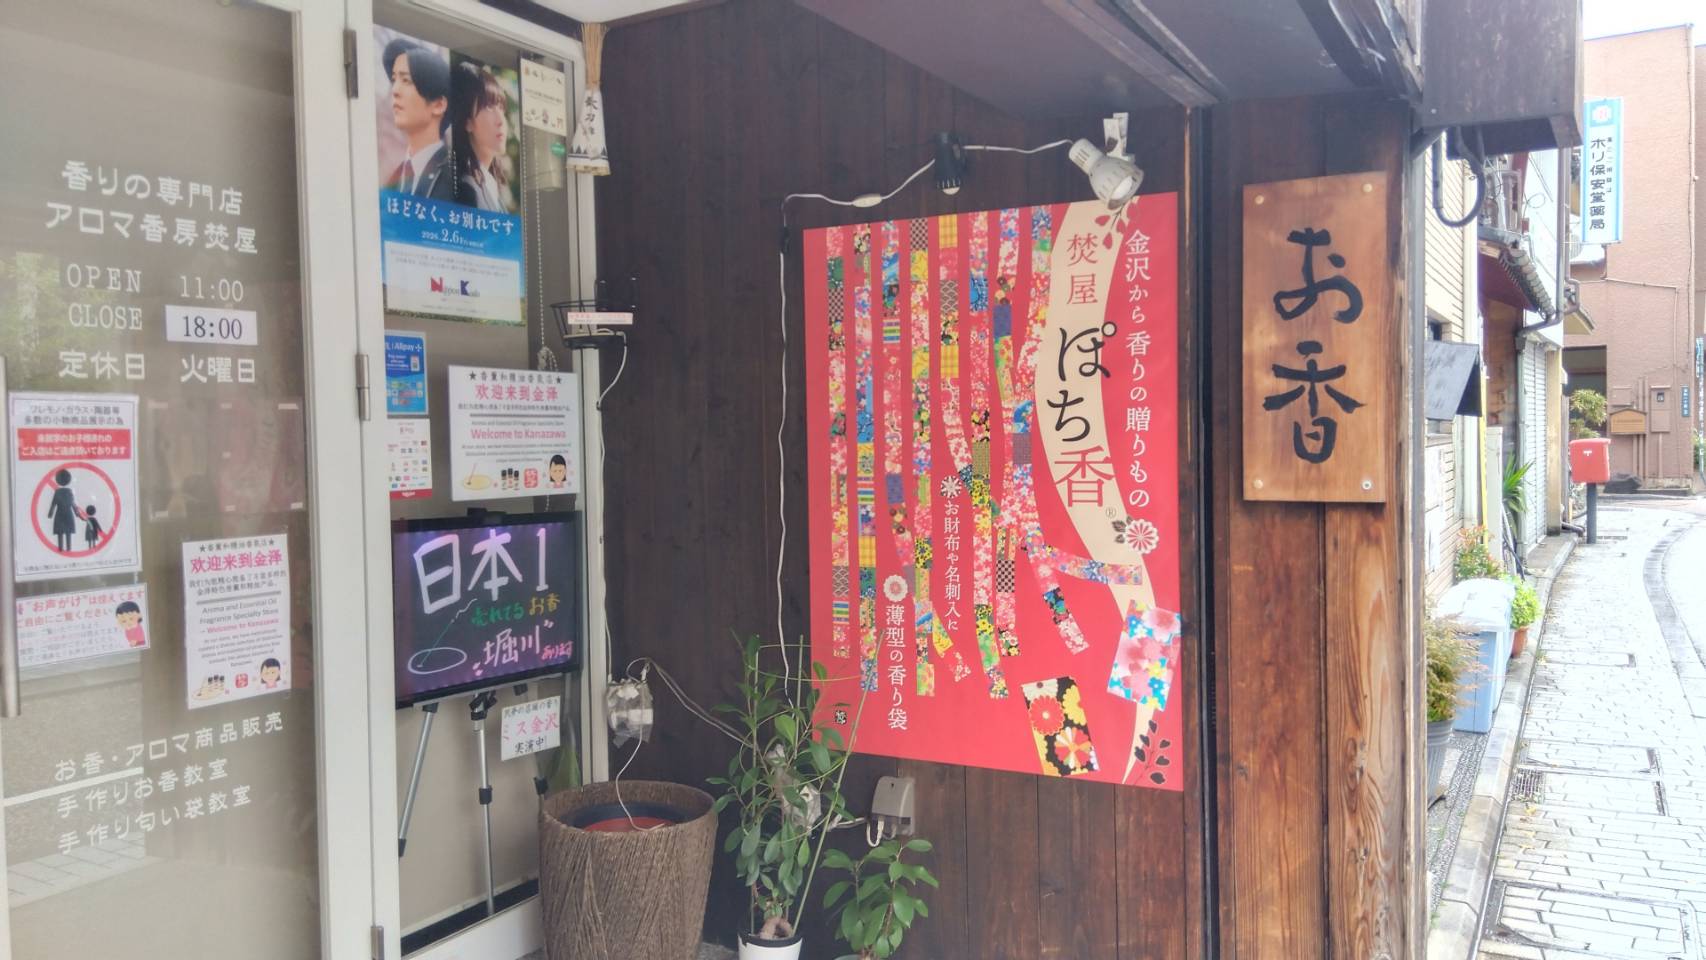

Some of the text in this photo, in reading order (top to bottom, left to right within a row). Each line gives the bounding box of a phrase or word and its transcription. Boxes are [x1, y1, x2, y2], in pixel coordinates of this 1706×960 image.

[61, 160, 243, 216] 香りの専門店
[45, 201, 258, 254] アロマ香房焚屋
[386, 197, 514, 236] ほどなく、お別れです
[66, 263, 244, 302] OPEN 11:00
[1066, 232, 1098, 306] 焚屋
[68, 302, 243, 340] CLOSE 18:00
[1263, 227, 1367, 464] お香
[58, 350, 256, 384] 定休日 火曜日
[1125, 229, 1151, 508] 金沢から香りの贈りもの
[470, 428, 566, 440] Welcome to Kanazawa
[1046, 321, 1117, 508] ぽち香
[190, 549, 282, 574] 欢迎来到金泽
[471, 592, 560, 627] 売れてる お香
[885, 604, 908, 731] 薄型の香り袋
[54, 711, 284, 782] お香・アロマ商品販売
[57, 758, 229, 818] 手作りお香教室
[57, 785, 252, 855] 手作り匂い袋教室
